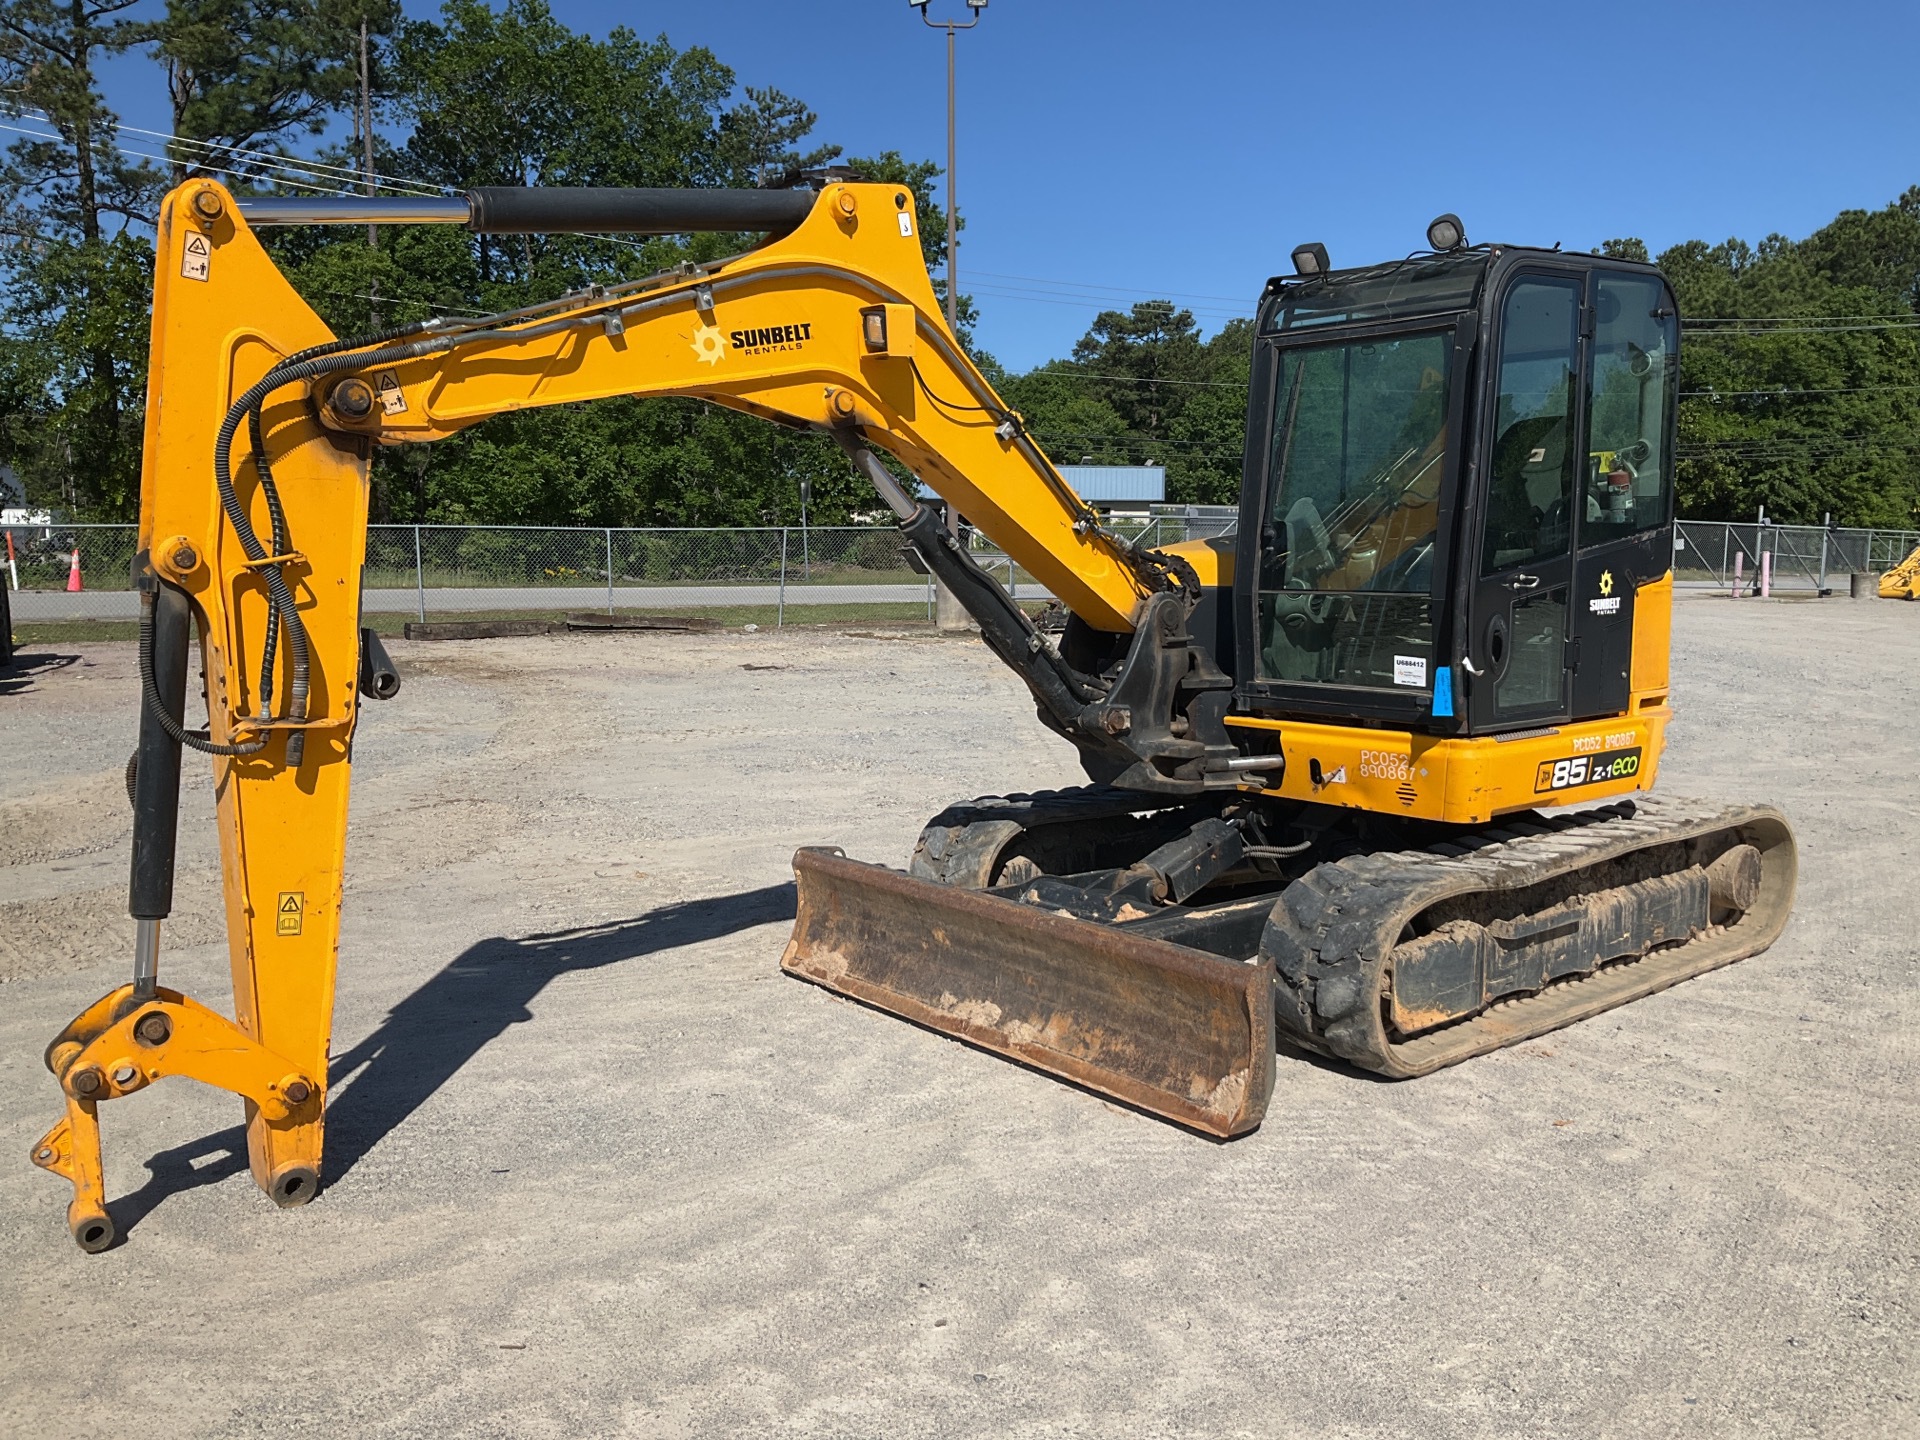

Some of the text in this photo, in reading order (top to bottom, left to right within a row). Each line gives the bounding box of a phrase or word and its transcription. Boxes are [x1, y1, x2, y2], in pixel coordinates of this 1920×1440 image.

[730, 323, 811, 349] SUNBELT
[745, 342, 803, 356] RENTALS
[1589, 596, 1621, 612] SUNBELT
[1396, 659, 1424, 668] U688412
[1360, 749, 1409, 769] PC052
[1360, 763, 1416, 781] 890867
[1551, 757, 1588, 788] 85
[1612, 755, 1638, 776] eco
